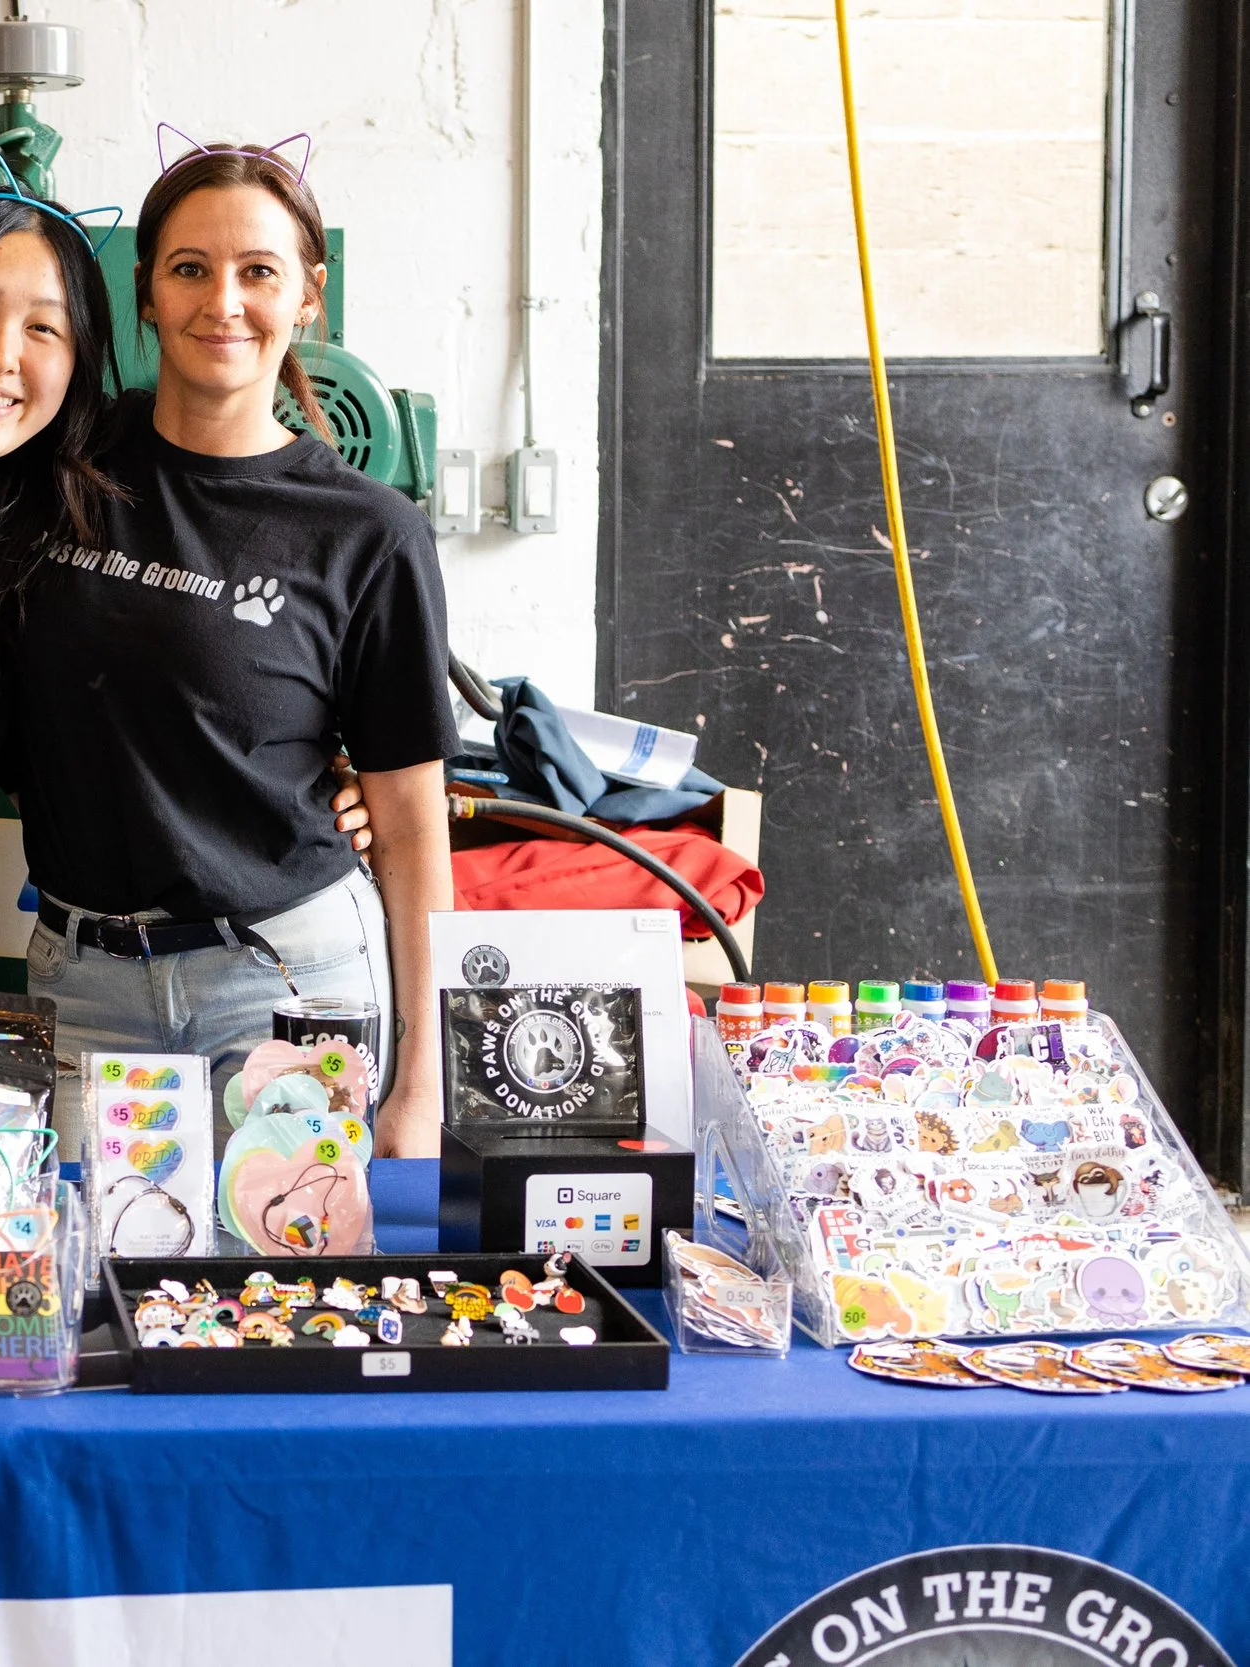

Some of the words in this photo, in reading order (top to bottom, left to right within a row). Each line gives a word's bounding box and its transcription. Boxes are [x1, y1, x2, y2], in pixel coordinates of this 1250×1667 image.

[71, 546, 101, 571] on
[101, 549, 140, 580] the
[141, 562, 226, 600] Ground
[482, 1020, 501, 1079] PAWS
[497, 994, 524, 1018] ON
[527, 988, 564, 1006] THE
[535, 1014, 551, 1023] THE
[551, 1017, 579, 1046] GROUND
[106, 1064, 121, 1077] $5
[326, 1055, 342, 1073] $5
[495, 1081, 596, 1121] DONATIONS
[113, 1107, 129, 1121] $5
[1085, 1118, 1088, 1128] I
[1092, 1116, 1116, 1128] CAN
[1093, 1130, 1116, 1143] BUY
[106, 1141, 121, 1155] $5
[319, 1143, 336, 1159] $3
[132, 1147, 182, 1166] PRIDE
[577, 1189, 622, 1204] Square
[15, 1220, 33, 1235] $4
[535, 1219, 557, 1228] VISA
[725, 1290, 754, 1302] 0.50
[844, 1311, 866, 1324] 50¢
[379, 1357, 396, 1370] $5
[811, 1585, 908, 1664] ON
[922, 1570, 1052, 1623] THE
